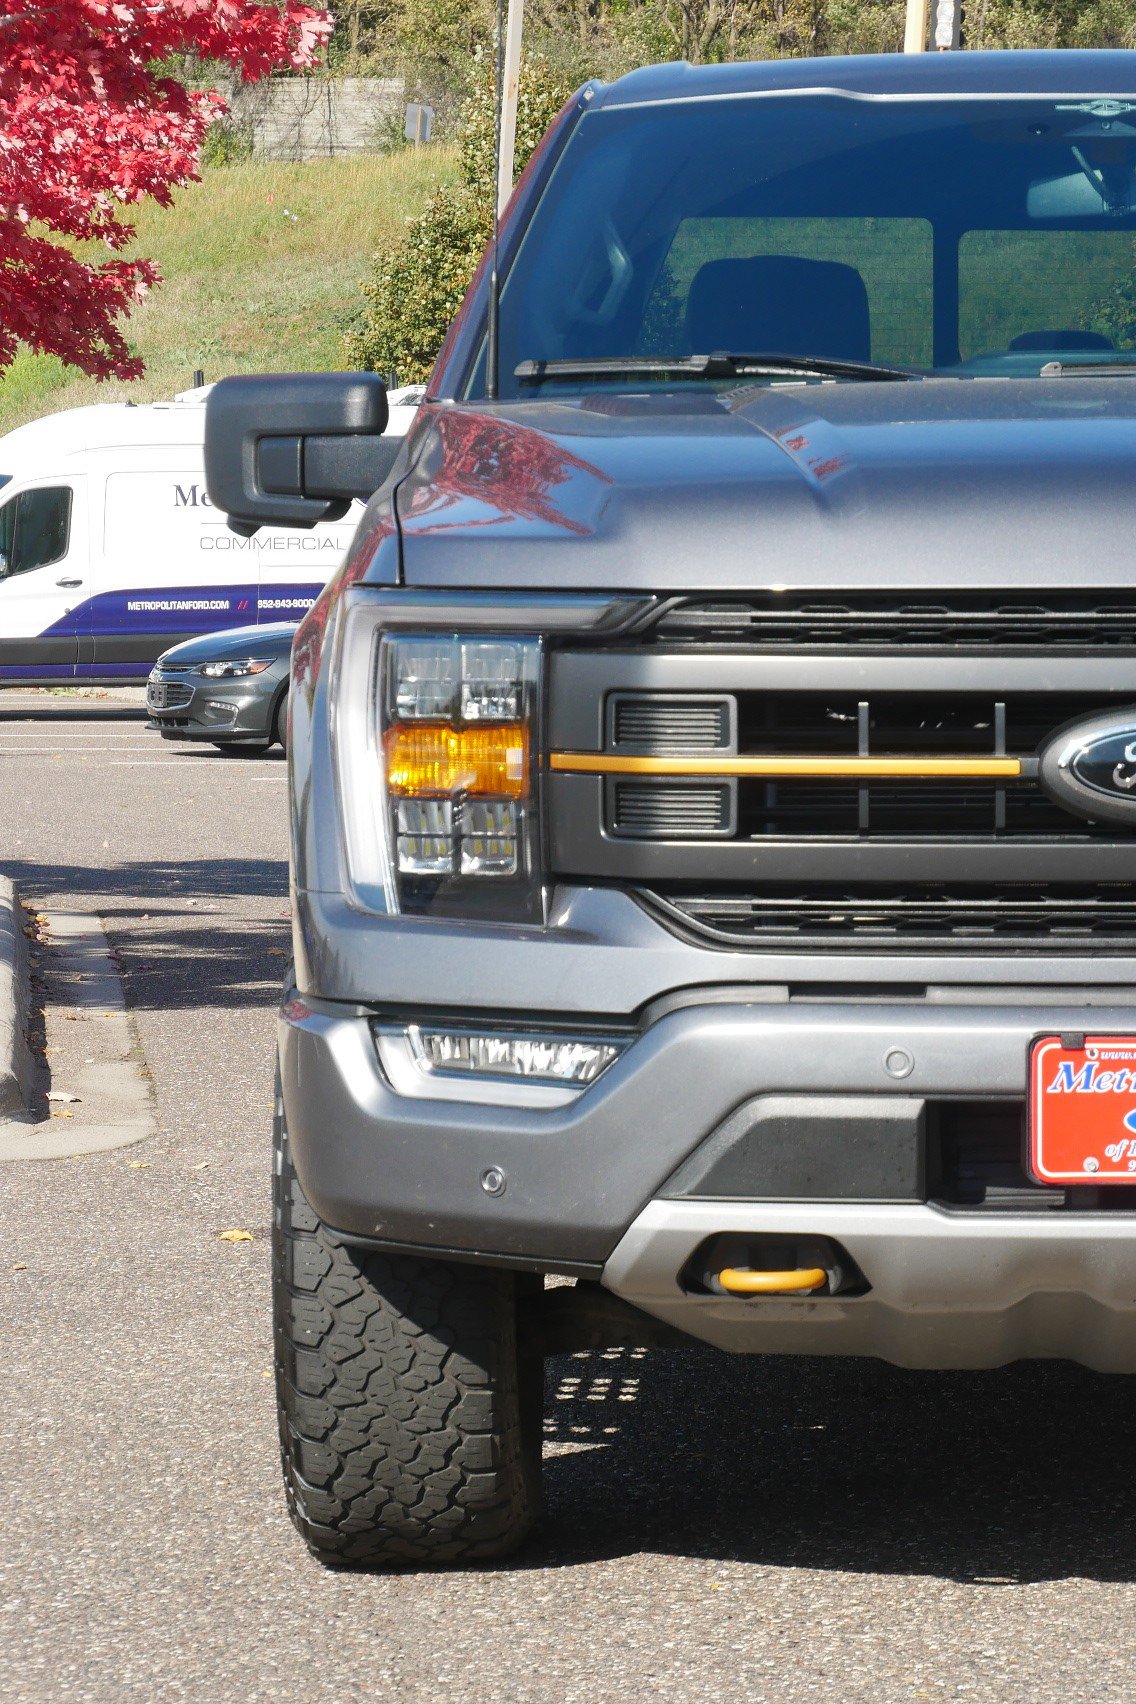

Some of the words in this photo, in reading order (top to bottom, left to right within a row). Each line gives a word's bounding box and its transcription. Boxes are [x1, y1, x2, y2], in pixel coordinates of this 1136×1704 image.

[200, 536, 347, 551] COMMERCIAL
[127, 600, 230, 611] METROPOLITANFORD.COM
[257, 599, 315, 609] 952-943-9000
[1104, 1139, 1129, 1162] of
